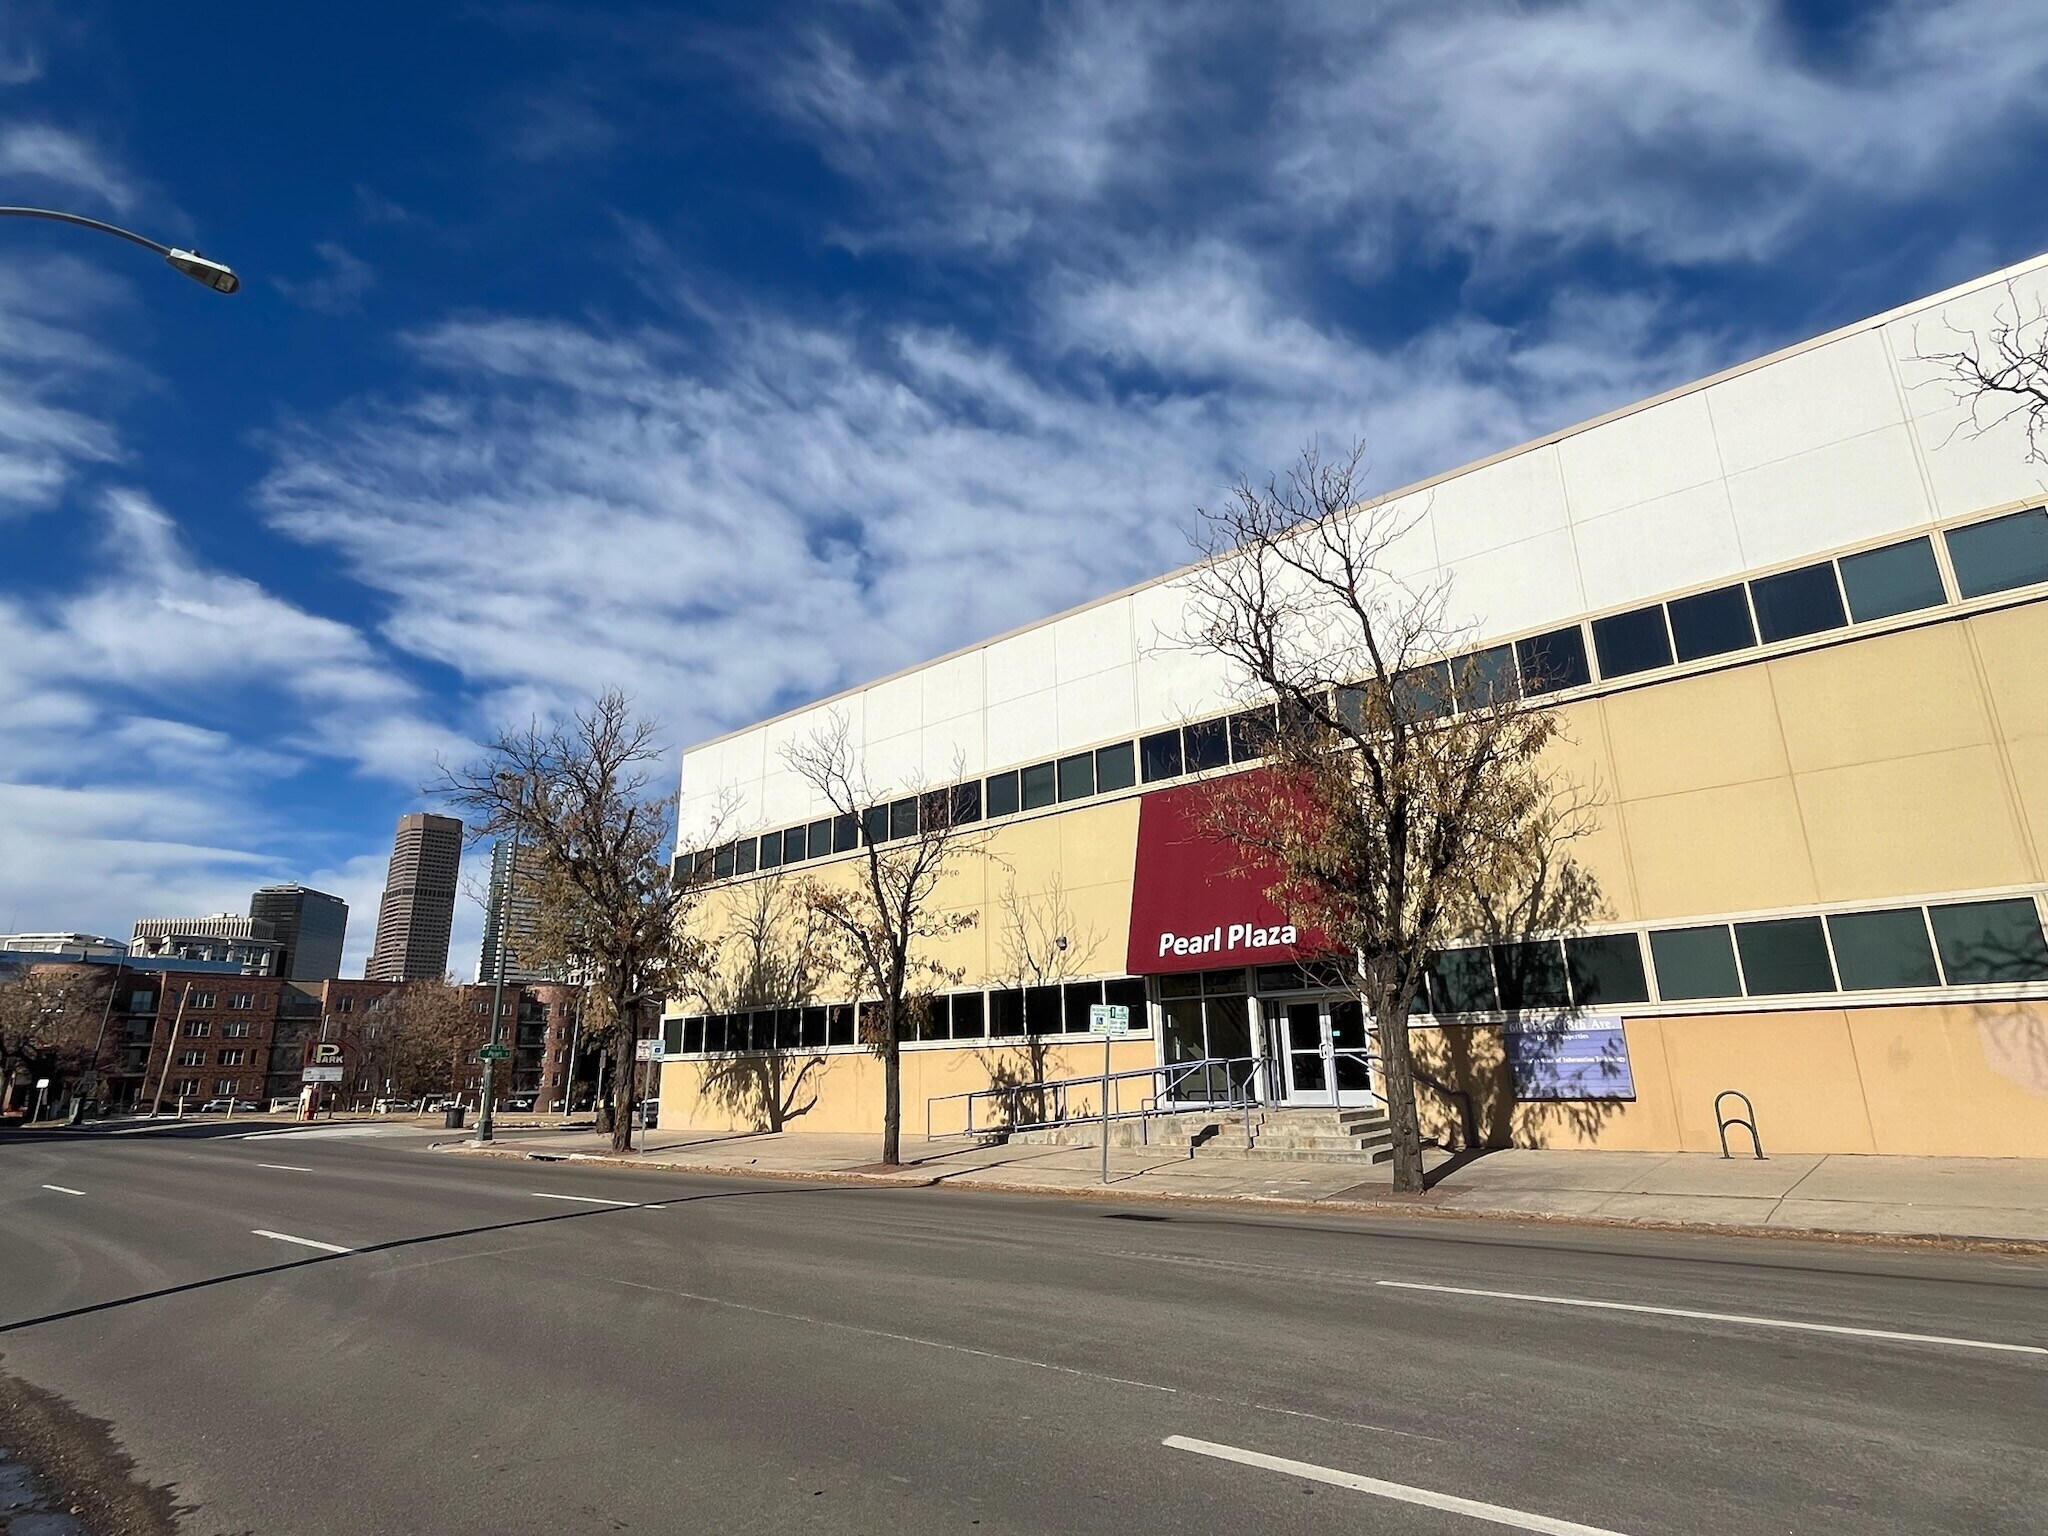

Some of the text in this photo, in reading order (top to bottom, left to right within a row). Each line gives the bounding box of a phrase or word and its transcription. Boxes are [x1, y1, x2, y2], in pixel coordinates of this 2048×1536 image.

[1158, 922, 1297, 957] Pearl Plaza
[1591, 1018, 1615, 1030] Ave.
[315, 1043, 344, 1064] PARK
